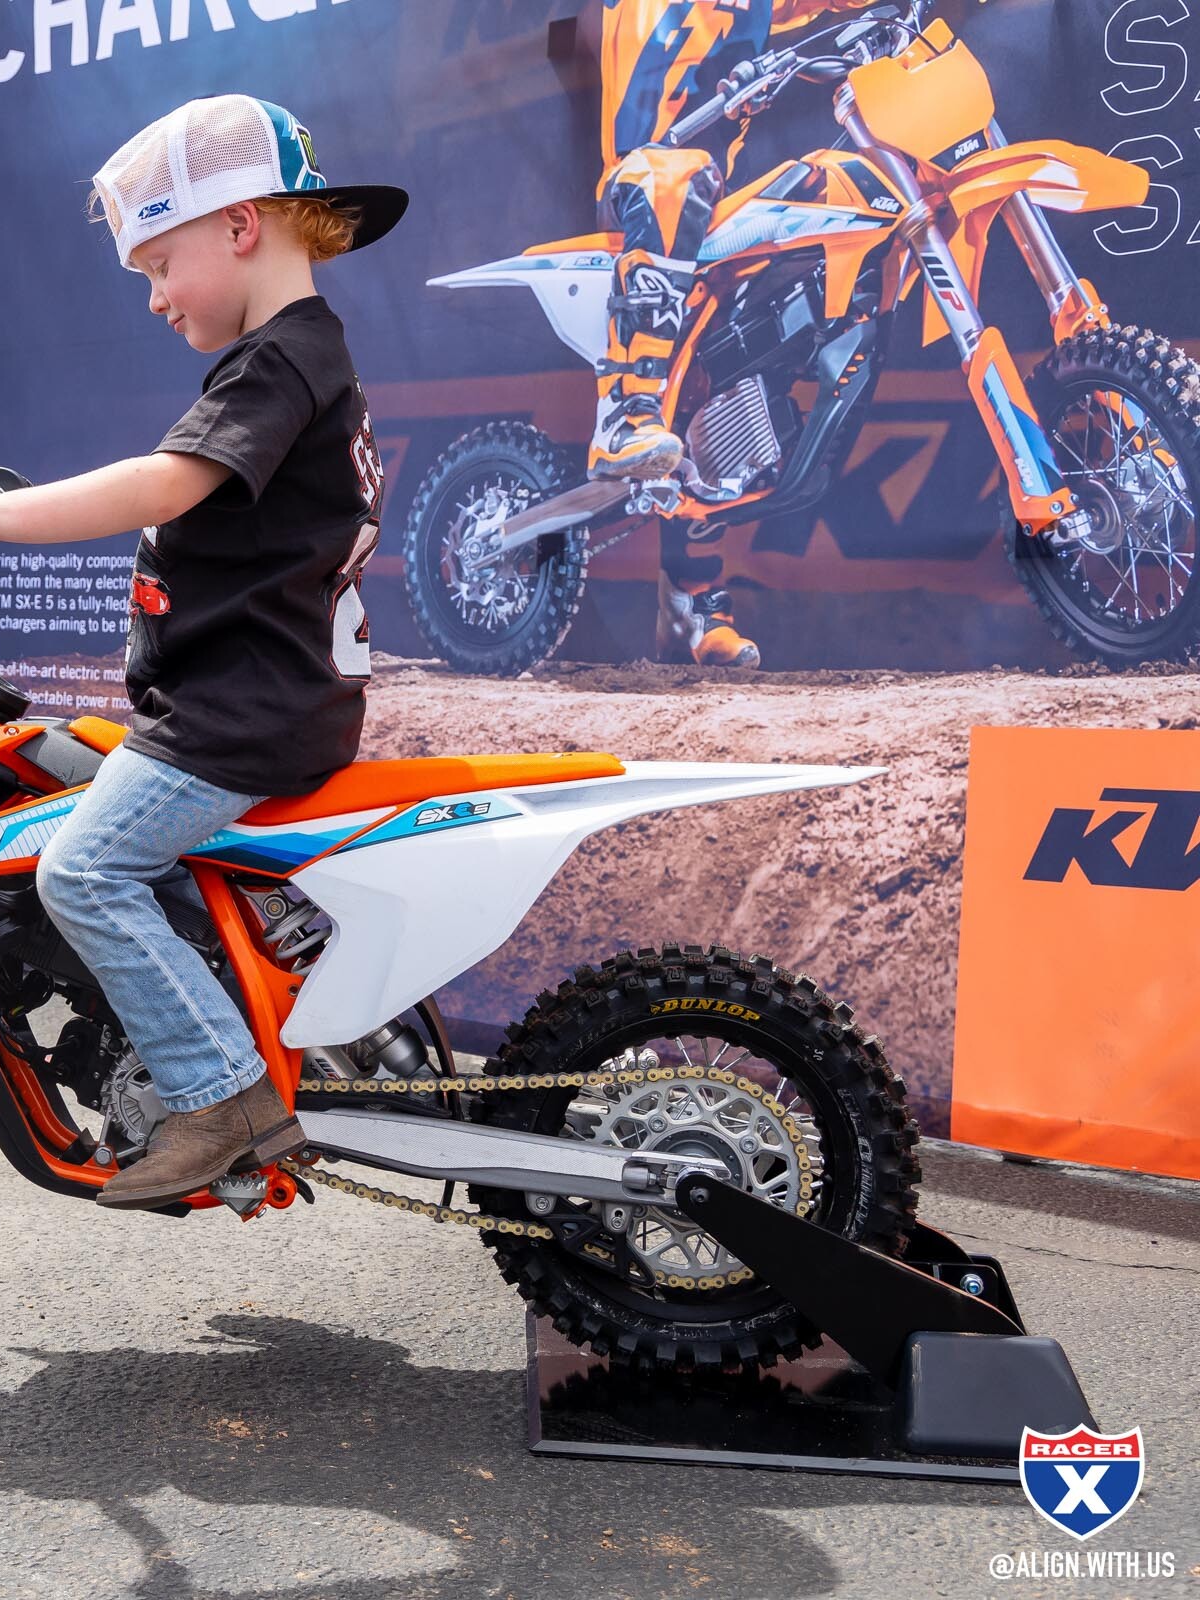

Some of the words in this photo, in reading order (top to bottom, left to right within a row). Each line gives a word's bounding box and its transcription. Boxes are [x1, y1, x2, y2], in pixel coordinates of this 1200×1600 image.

[955, 138, 980, 162] KTM
[870, 195, 900, 213] KTM
[21, 553, 84, 571] high-quality
[16, 574, 41, 589] from
[44, 575, 62, 589] the
[64, 578, 92, 592] many
[15, 596, 42, 610] SX-E
[46, 596, 54, 610] 5
[57, 597, 67, 611] is
[69, 599, 76, 611] a
[0, 616, 46, 632] chargers
[49, 617, 86, 634] aiming
[88, 618, 99, 632] to
[102, 618, 116, 632] be
[59, 664, 100, 680] electric
[75, 695, 109, 709] power
[663, 997, 761, 1023] DUNLOP
